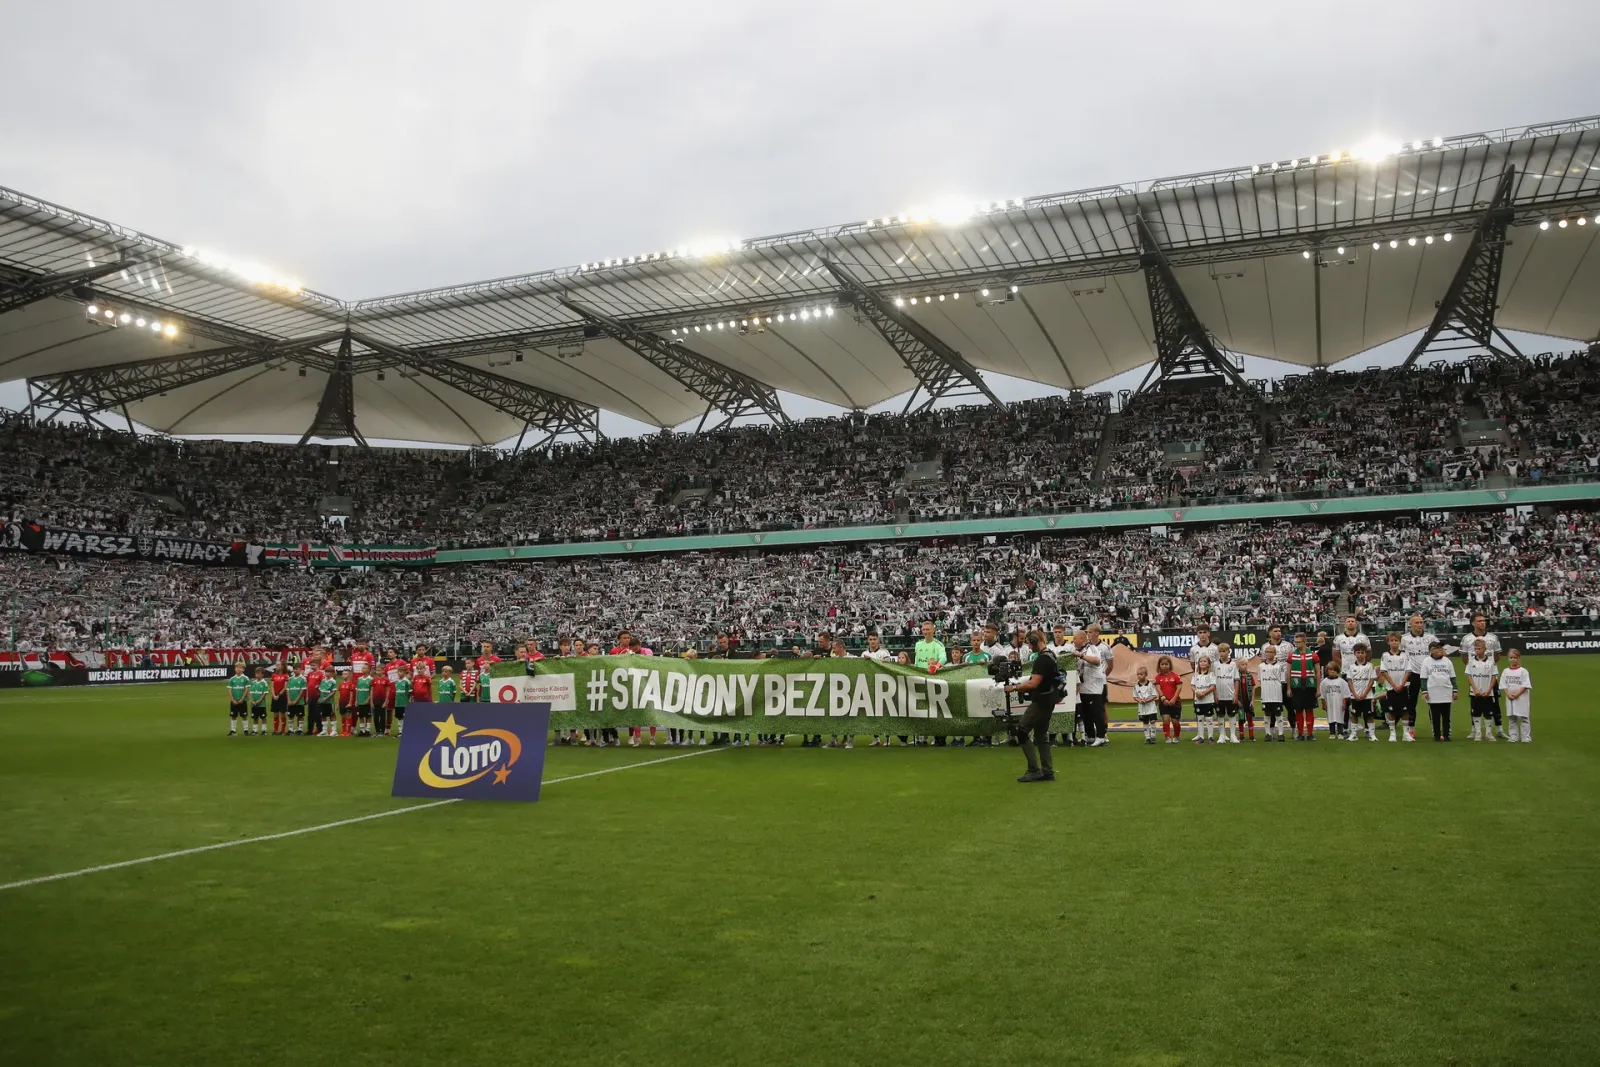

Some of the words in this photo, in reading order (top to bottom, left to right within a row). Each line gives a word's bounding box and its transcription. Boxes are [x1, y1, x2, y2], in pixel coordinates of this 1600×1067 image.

[43, 531, 135, 554] WARSZ
[1234, 634, 1256, 646] 4.10
[1234, 647, 1260, 659] MASZ
[89, 669, 122, 681] WEJŚCIE
[123, 671, 134, 680] NA
[135, 670, 160, 679] MECZ?
[160, 669, 180, 679] MASZ
[181, 669, 190, 678] TO
[191, 668, 199, 677] W
[200, 668, 228, 678] KIESZENI
[586, 667, 760, 717] #STADIONY
[764, 673, 826, 717] BEZ
[829, 673, 953, 719] BARIER
[441, 740, 501, 776] LOTTO
